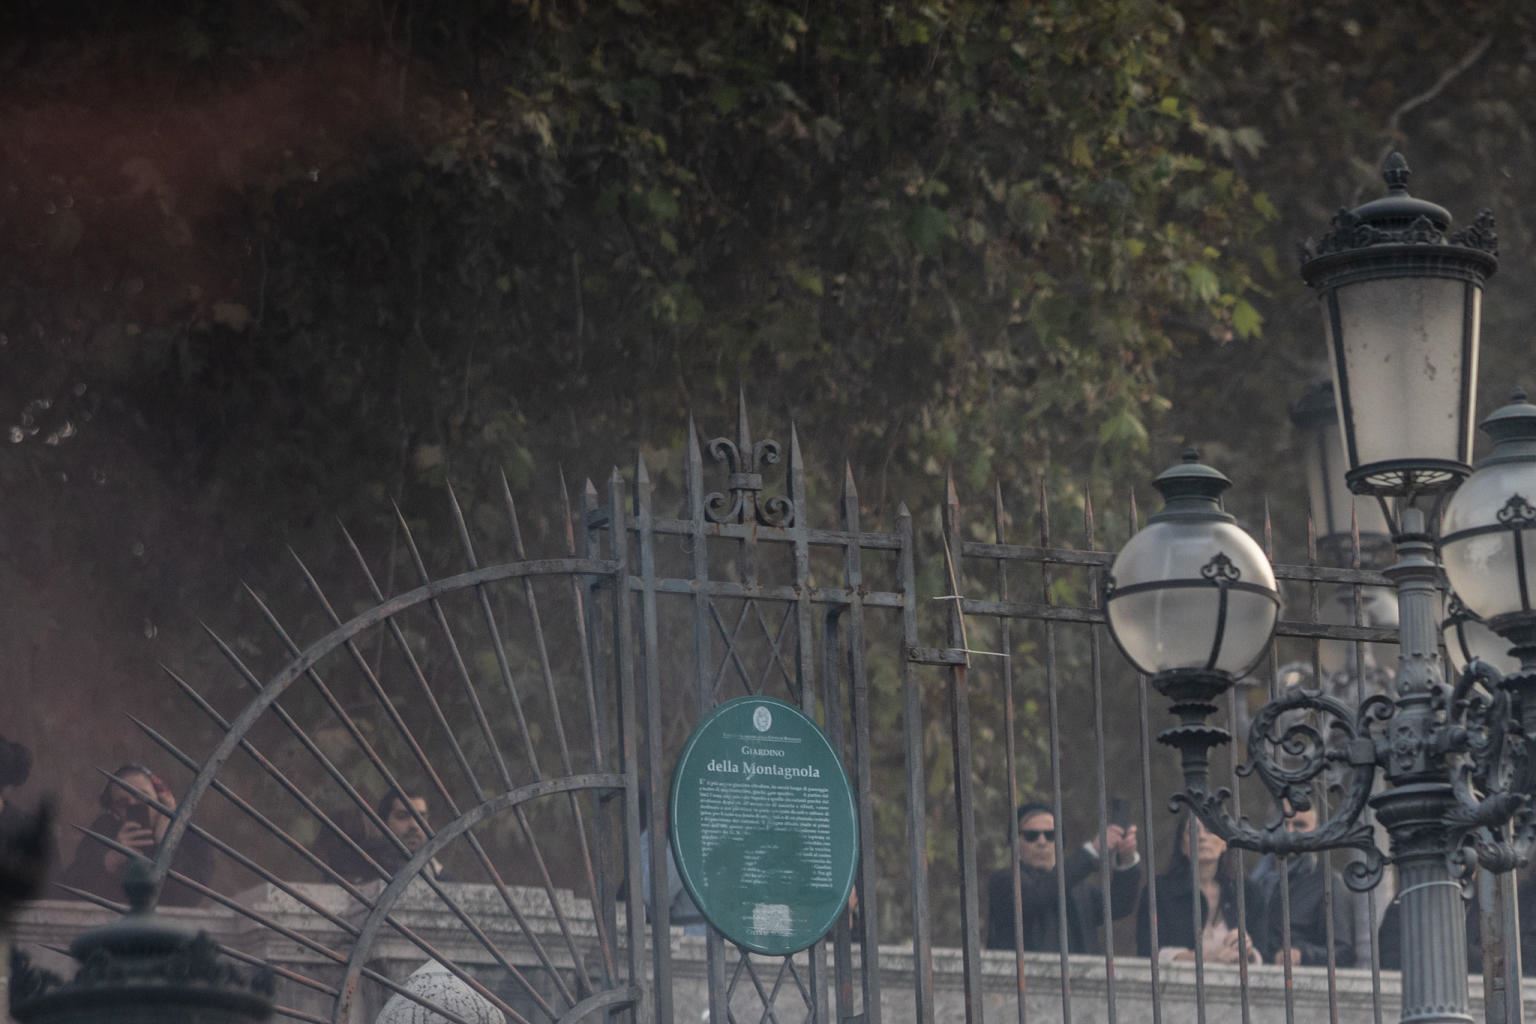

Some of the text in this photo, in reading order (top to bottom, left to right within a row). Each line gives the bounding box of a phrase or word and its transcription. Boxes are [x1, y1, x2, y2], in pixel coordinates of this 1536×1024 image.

[741, 745, 785, 757] GIARDINO
[707, 760, 821, 780] della Montagnola
